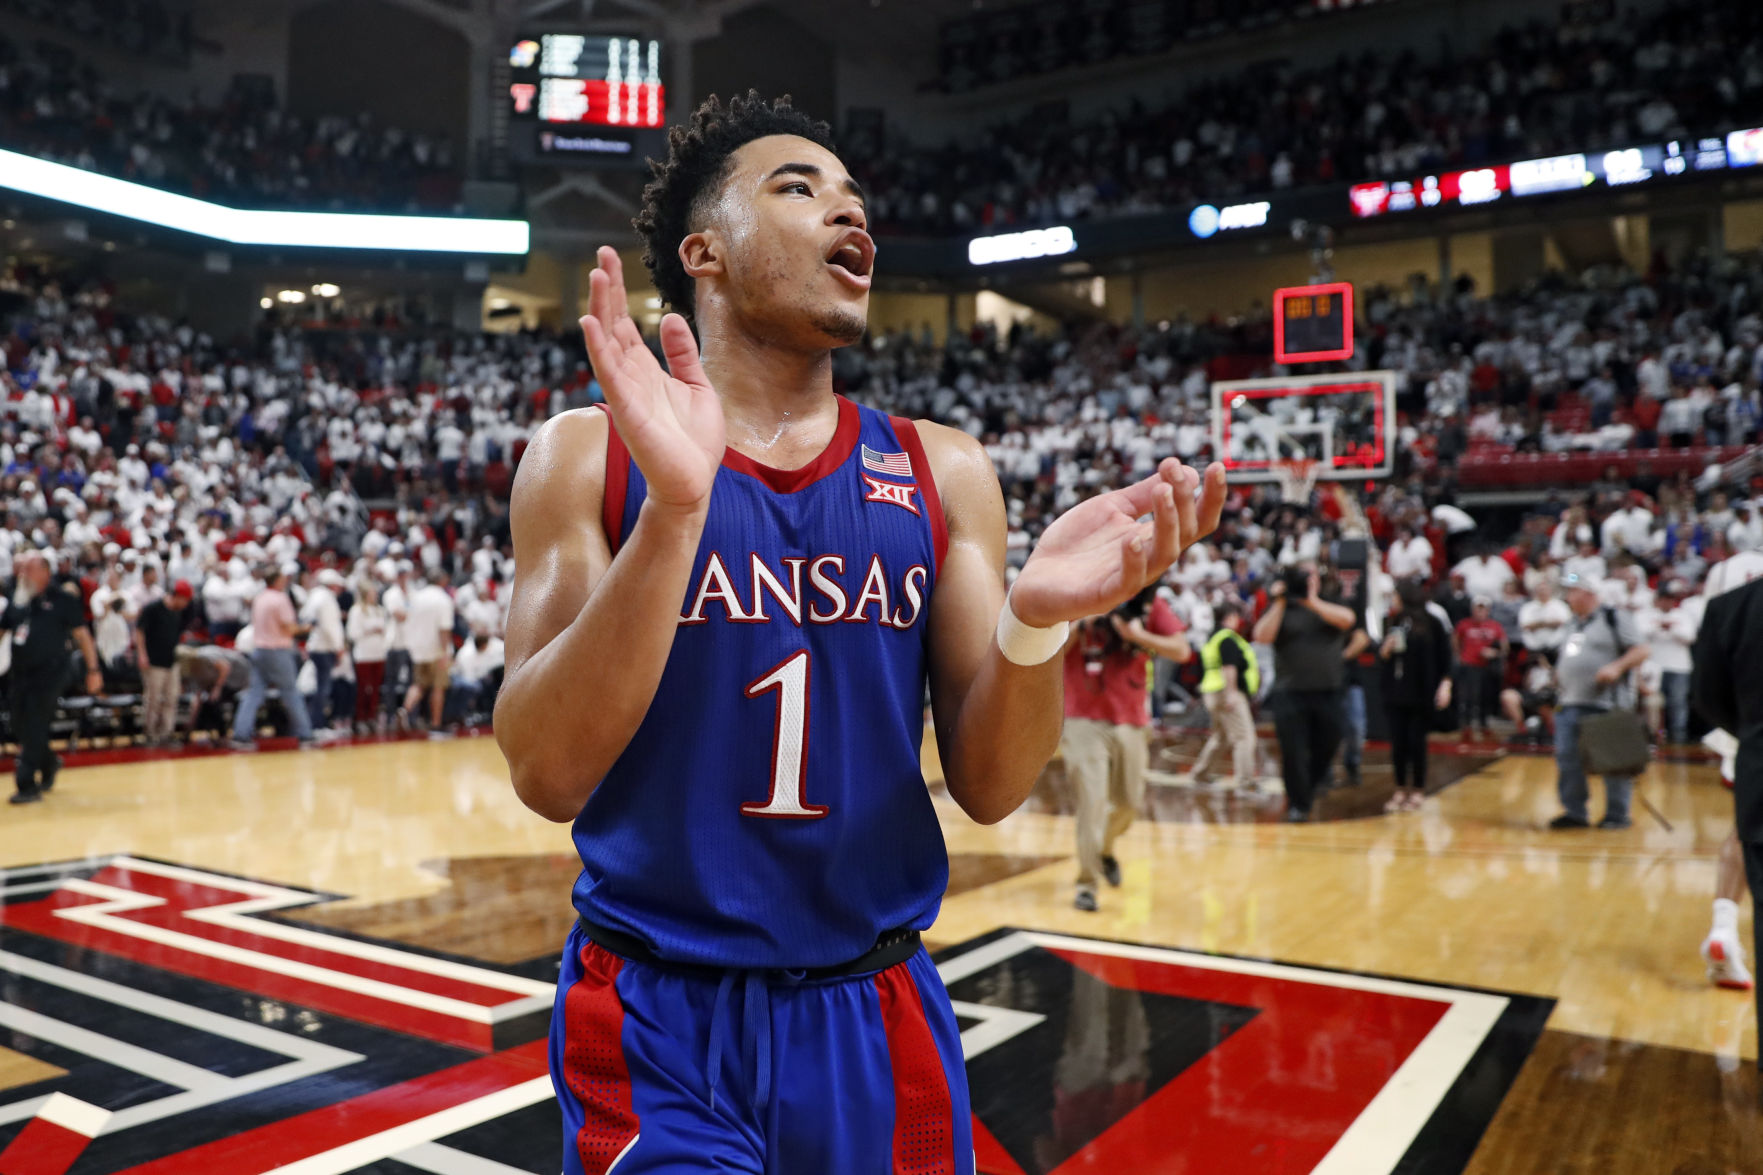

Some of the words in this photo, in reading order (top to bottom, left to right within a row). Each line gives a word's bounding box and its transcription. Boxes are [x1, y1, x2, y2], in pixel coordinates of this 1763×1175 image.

[863, 475, 919, 514] XII
[678, 551, 927, 630] ANSAS
[740, 649, 830, 819] 1
